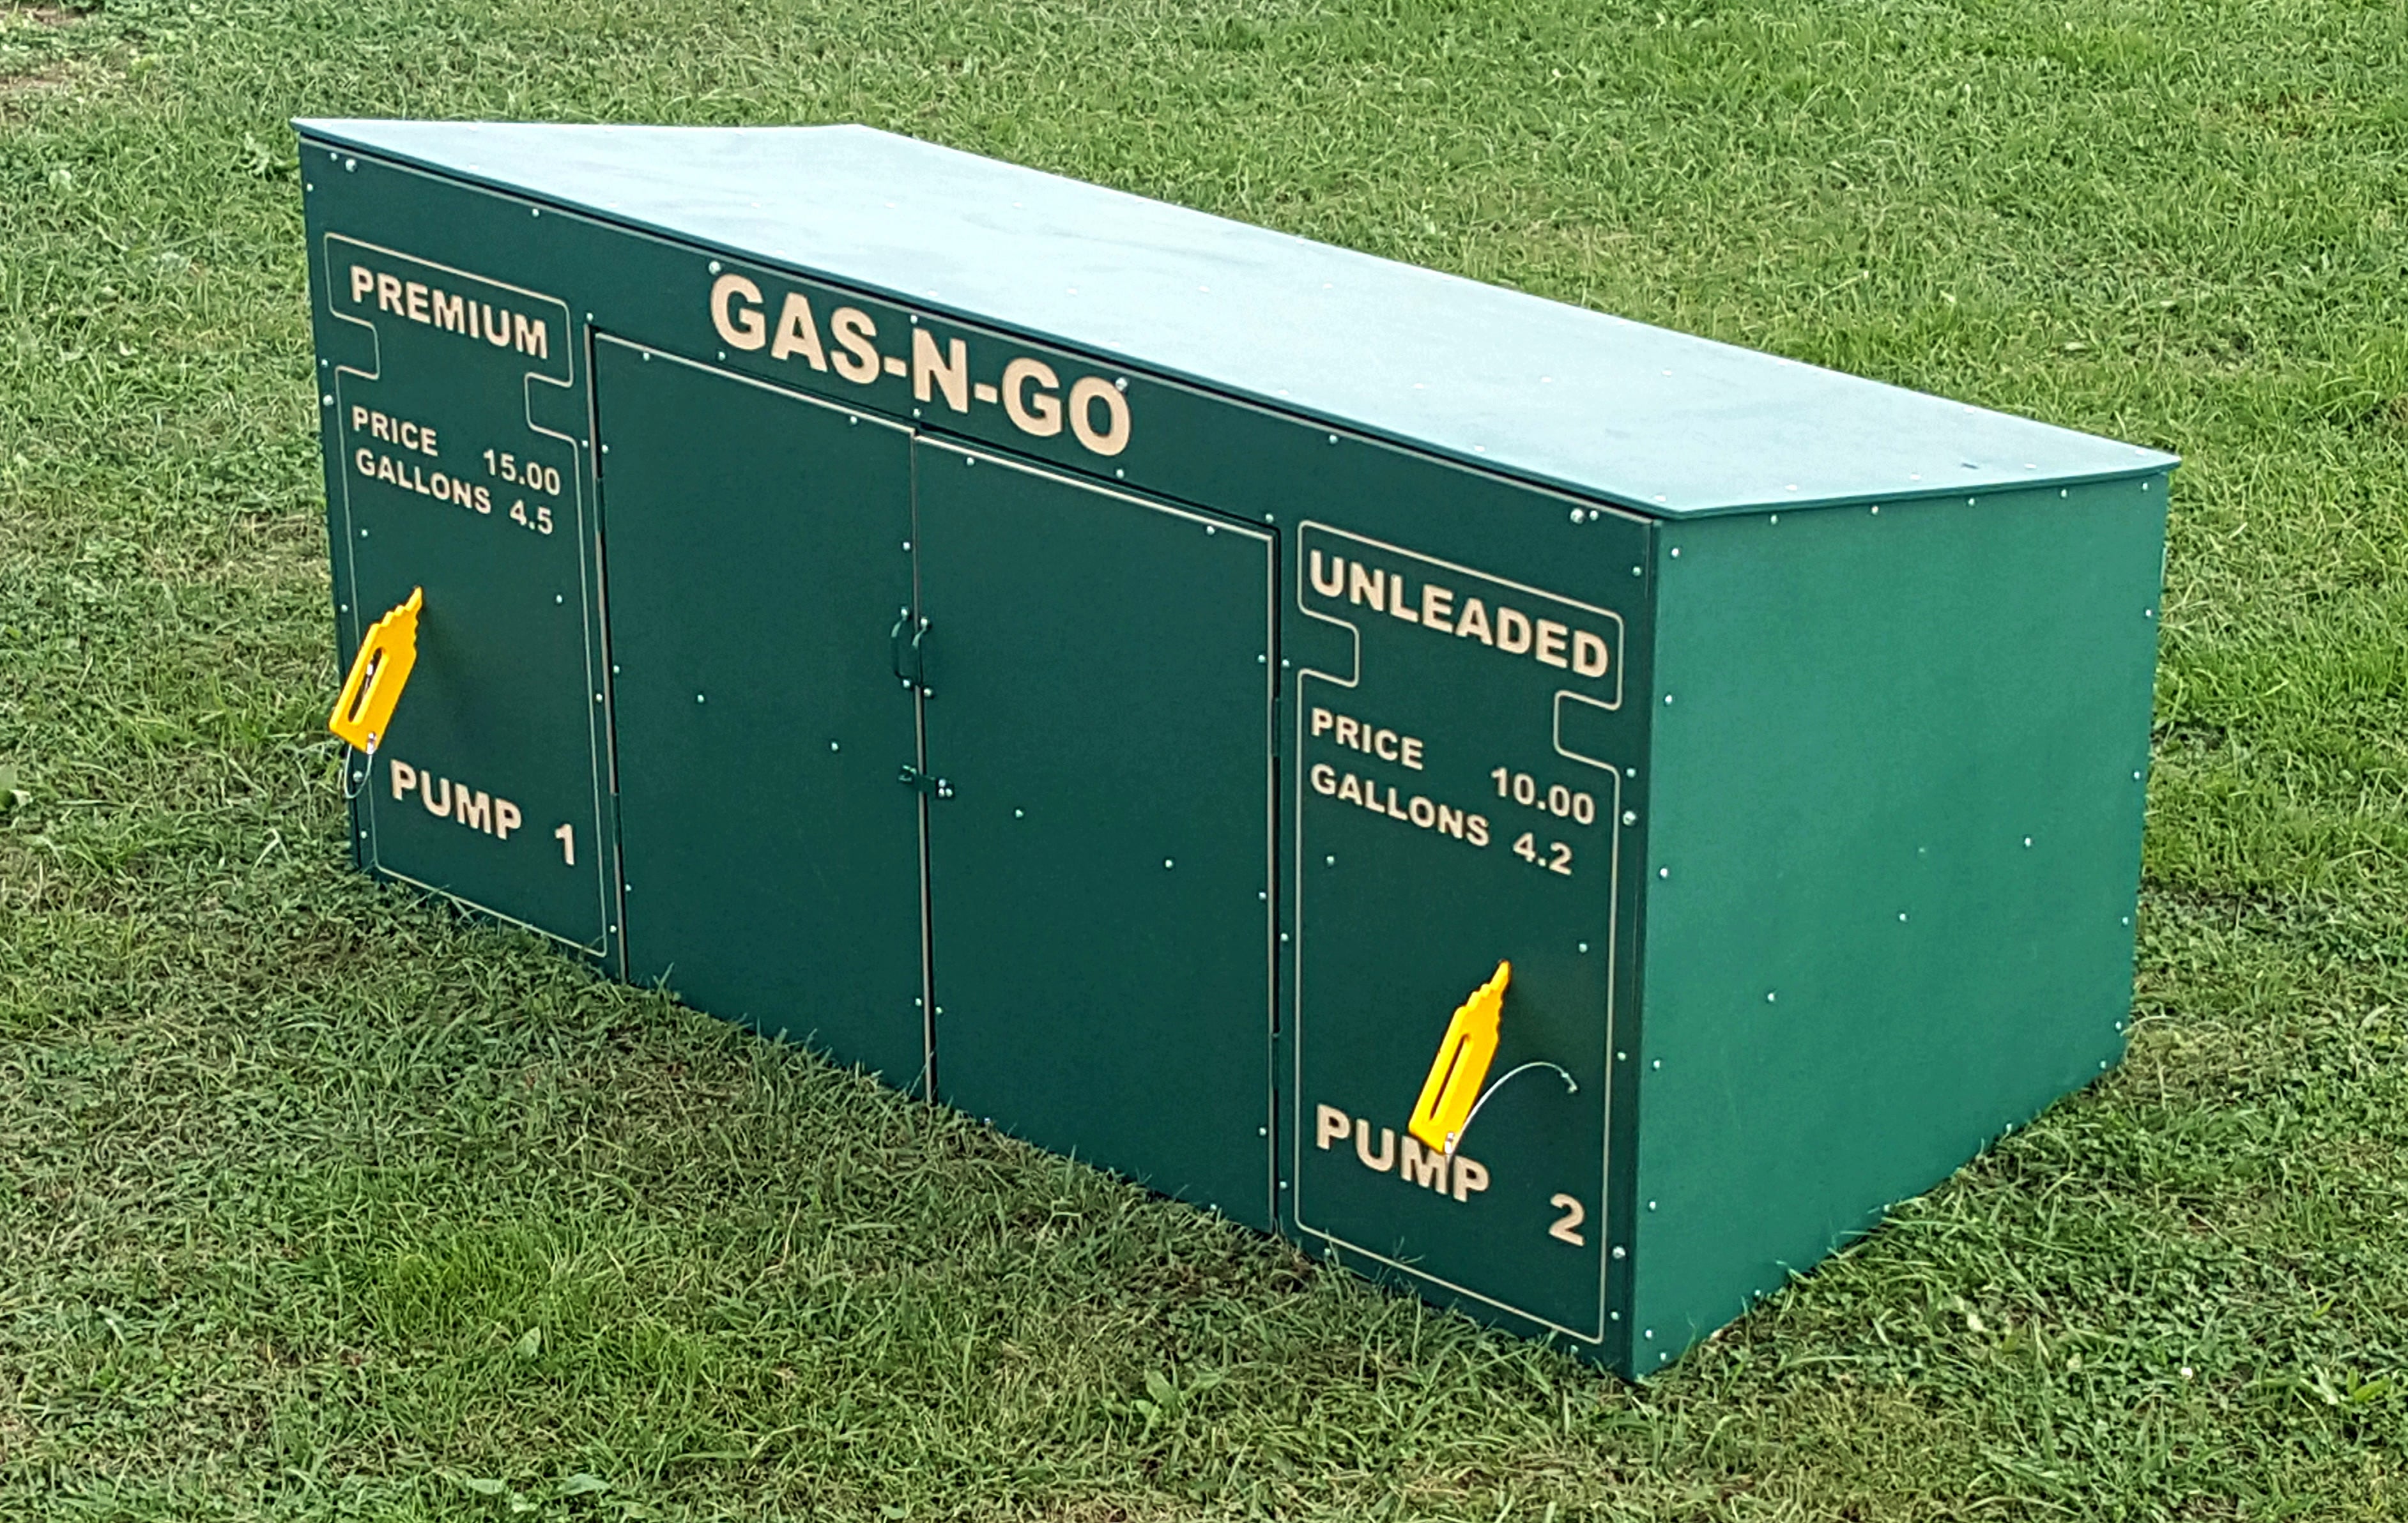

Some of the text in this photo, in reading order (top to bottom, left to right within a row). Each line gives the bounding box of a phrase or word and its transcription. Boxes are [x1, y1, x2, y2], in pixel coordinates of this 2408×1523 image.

[351, 265, 548, 360] PREMIUM
[710, 273, 1131, 456] GAS-N-GO
[352, 405, 561, 496] PRICE 15.00
[355, 448, 553, 535] GALLONS 4.5
[1310, 549, 1609, 678] UNLEADED
[390, 759, 574, 866] PUMP 1
[1310, 763, 1572, 875] GALLONS 4.2
[1311, 707, 1595, 825] PRICE 10.00
[1317, 1103, 1586, 1246] PUMP 2
